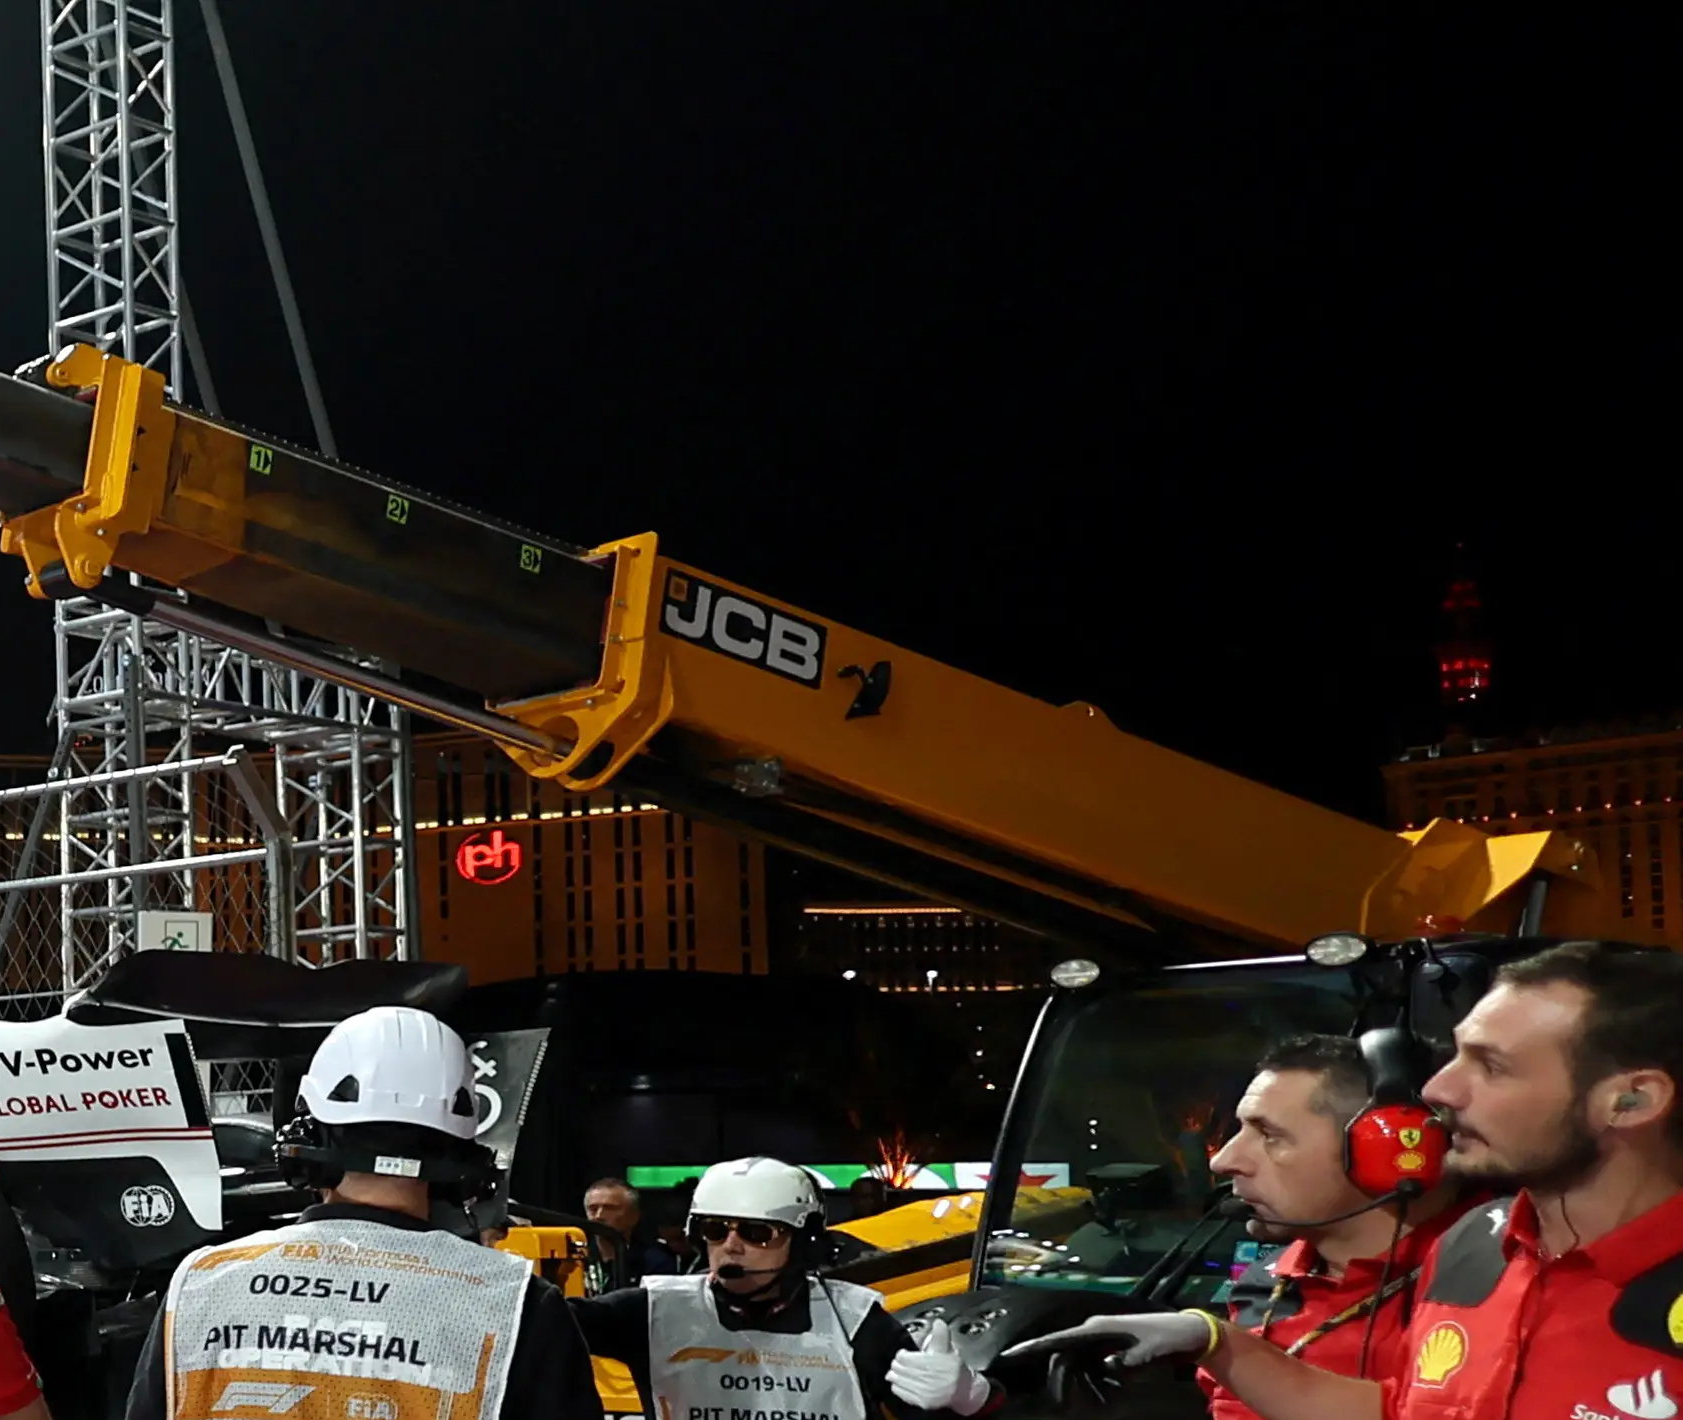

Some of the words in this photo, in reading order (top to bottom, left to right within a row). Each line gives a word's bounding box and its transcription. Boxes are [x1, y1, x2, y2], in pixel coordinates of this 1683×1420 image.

[665, 586, 819, 679] JCB
[82, 1086, 171, 1110] POKER
[125, 1194, 169, 1219] FIA
[250, 1273, 391, 1303] 0025-LV
[203, 1325, 248, 1351] PIT
[258, 1325, 427, 1366] MARSHAL
[720, 1374, 811, 1393] 0019-LV
